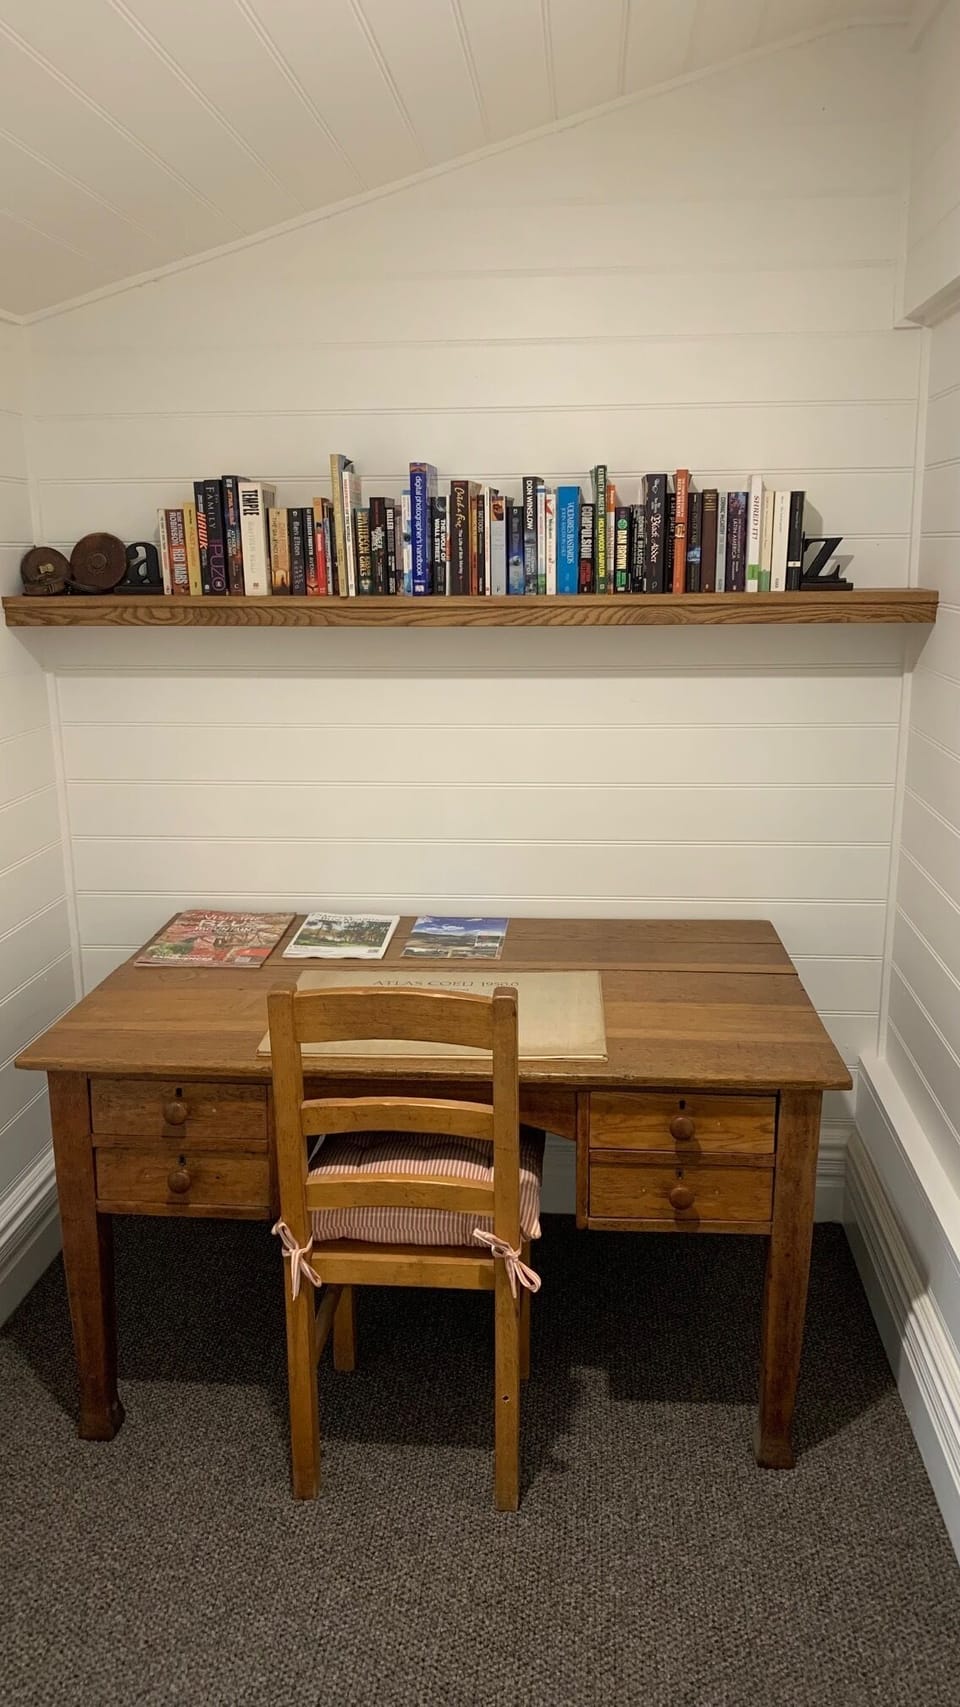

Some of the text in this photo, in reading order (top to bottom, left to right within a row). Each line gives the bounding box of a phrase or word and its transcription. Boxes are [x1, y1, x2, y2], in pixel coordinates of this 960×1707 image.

[205, 487, 216, 529] FAMILY
[242, 490, 259, 516] TEMPLE
[386, 509, 394, 530] KILLER
[526, 496, 534, 530] WINSLOW
[752, 495, 760, 526] SHRED
[169, 512, 179, 546] ROBINSON
[196, 512, 208, 550] HAWK
[358, 516, 371, 554] PATTERSON
[414, 475, 424, 576] digital photographer's handbook
[581, 505, 593, 559] COMPULSION
[617, 530, 627, 544] DAN
[173, 548, 188, 584] RED MARS
[210, 544, 226, 591] PUZO
[359, 556, 367, 577] GIRLS
[440, 552, 446, 562] OF
[616, 545, 627, 570] BROWN
